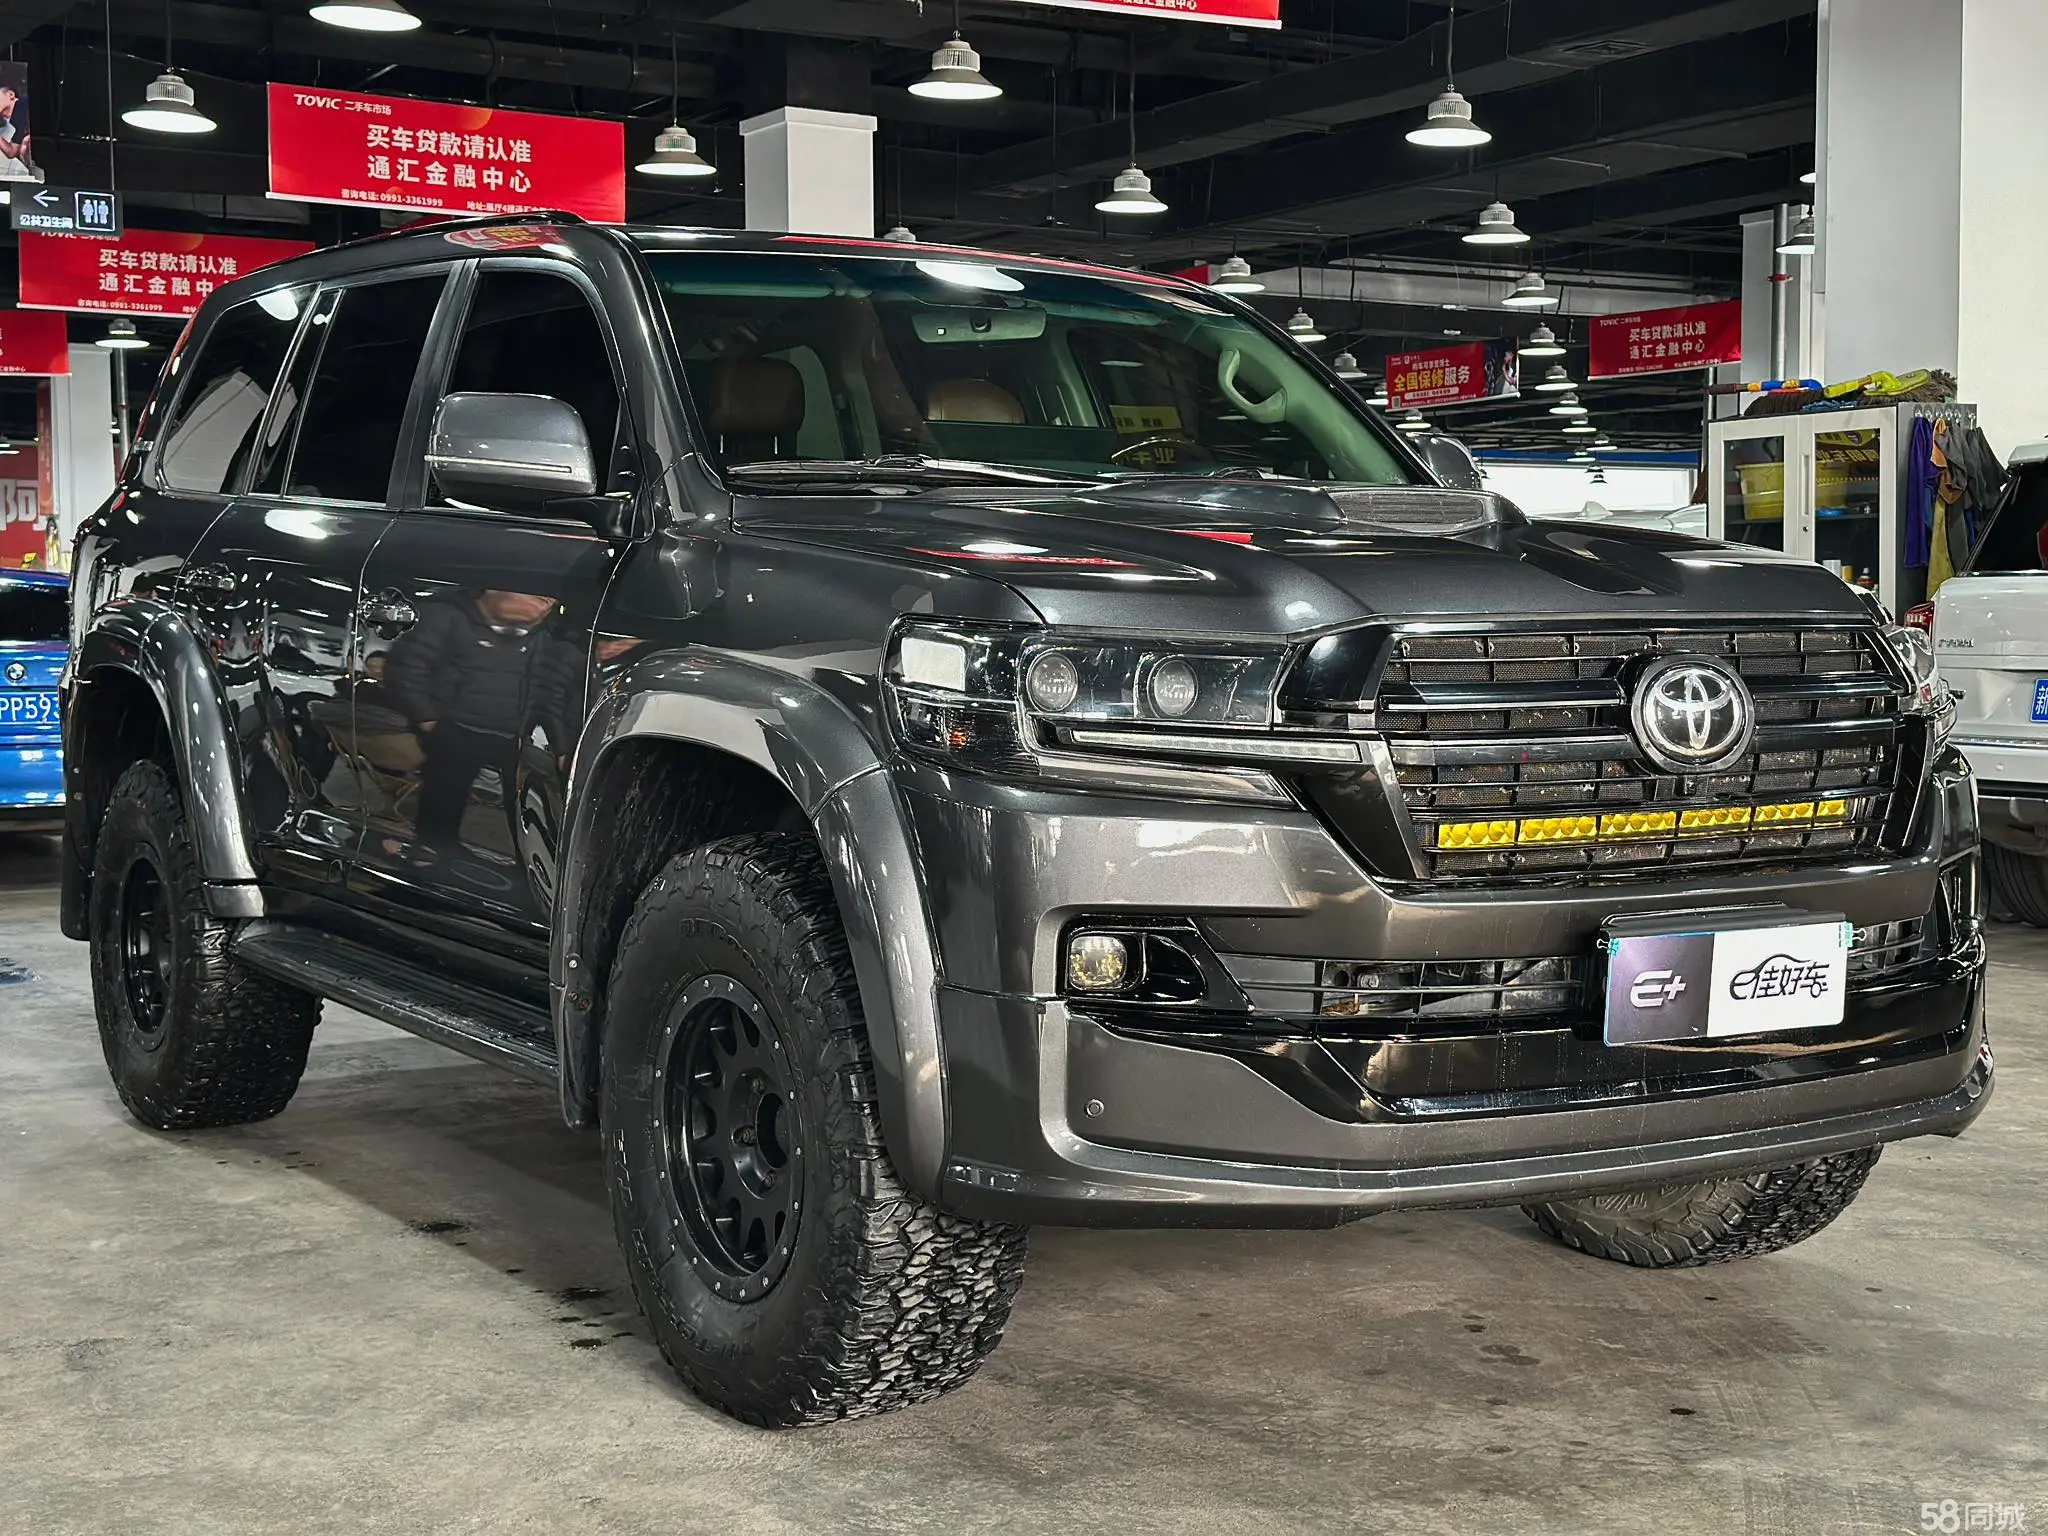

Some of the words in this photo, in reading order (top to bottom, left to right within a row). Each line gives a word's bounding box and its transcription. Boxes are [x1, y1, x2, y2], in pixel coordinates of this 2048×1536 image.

[294, 93, 342, 109] TOVIC
[345, 101, 392, 115] 二手车市场
[367, 124, 532, 163] 买车贷款请认准
[367, 155, 531, 192] 通汇金融中心
[99, 248, 237, 275] 买车贷款请认准
[98, 272, 230, 298] 通汇金融中
[1629, 321, 1707, 342] 买车贷款请认准
[1629, 339, 1705, 360] 通汇金融中心
[1394, 365, 1470, 392] 全国保修服务
